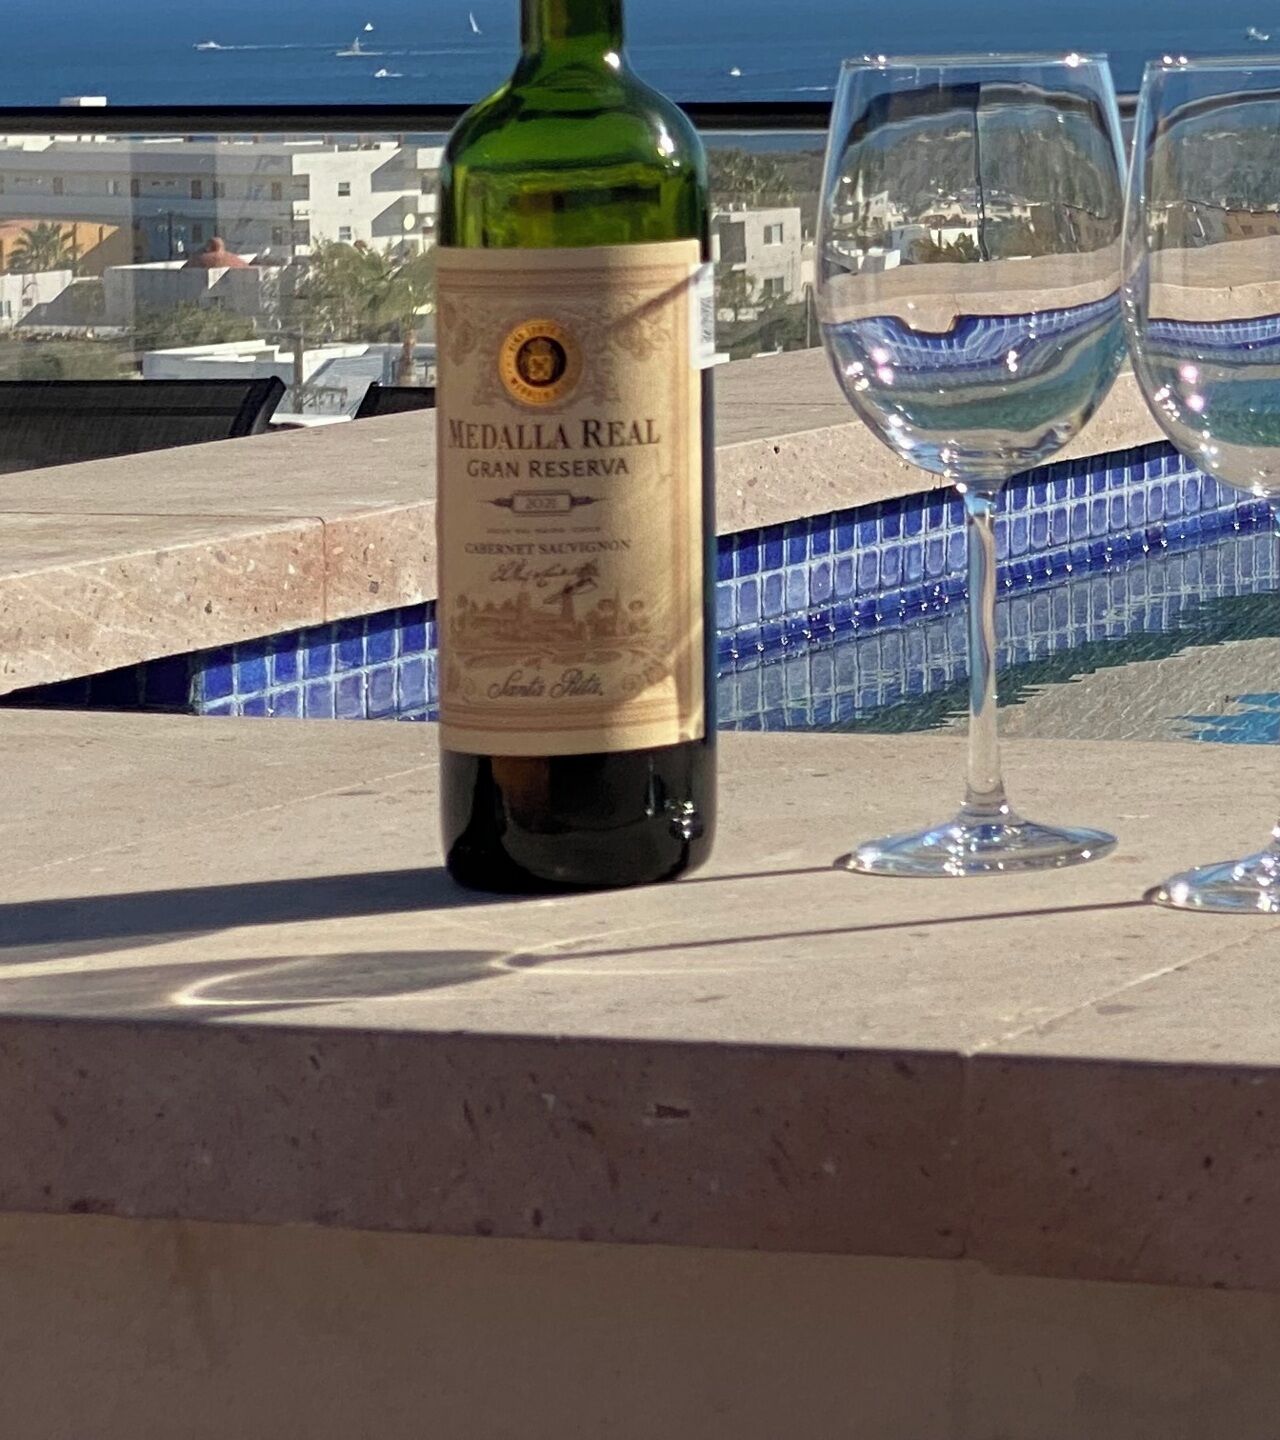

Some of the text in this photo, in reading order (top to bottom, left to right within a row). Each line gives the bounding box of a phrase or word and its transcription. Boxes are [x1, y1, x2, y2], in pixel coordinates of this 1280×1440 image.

[449, 418, 661, 450] MEDALLA REAL
[467, 458, 629, 478] GRAN RESERVA
[464, 539, 632, 555] CABERNET SAUVIGNON
[487, 671, 545, 699] Santa
